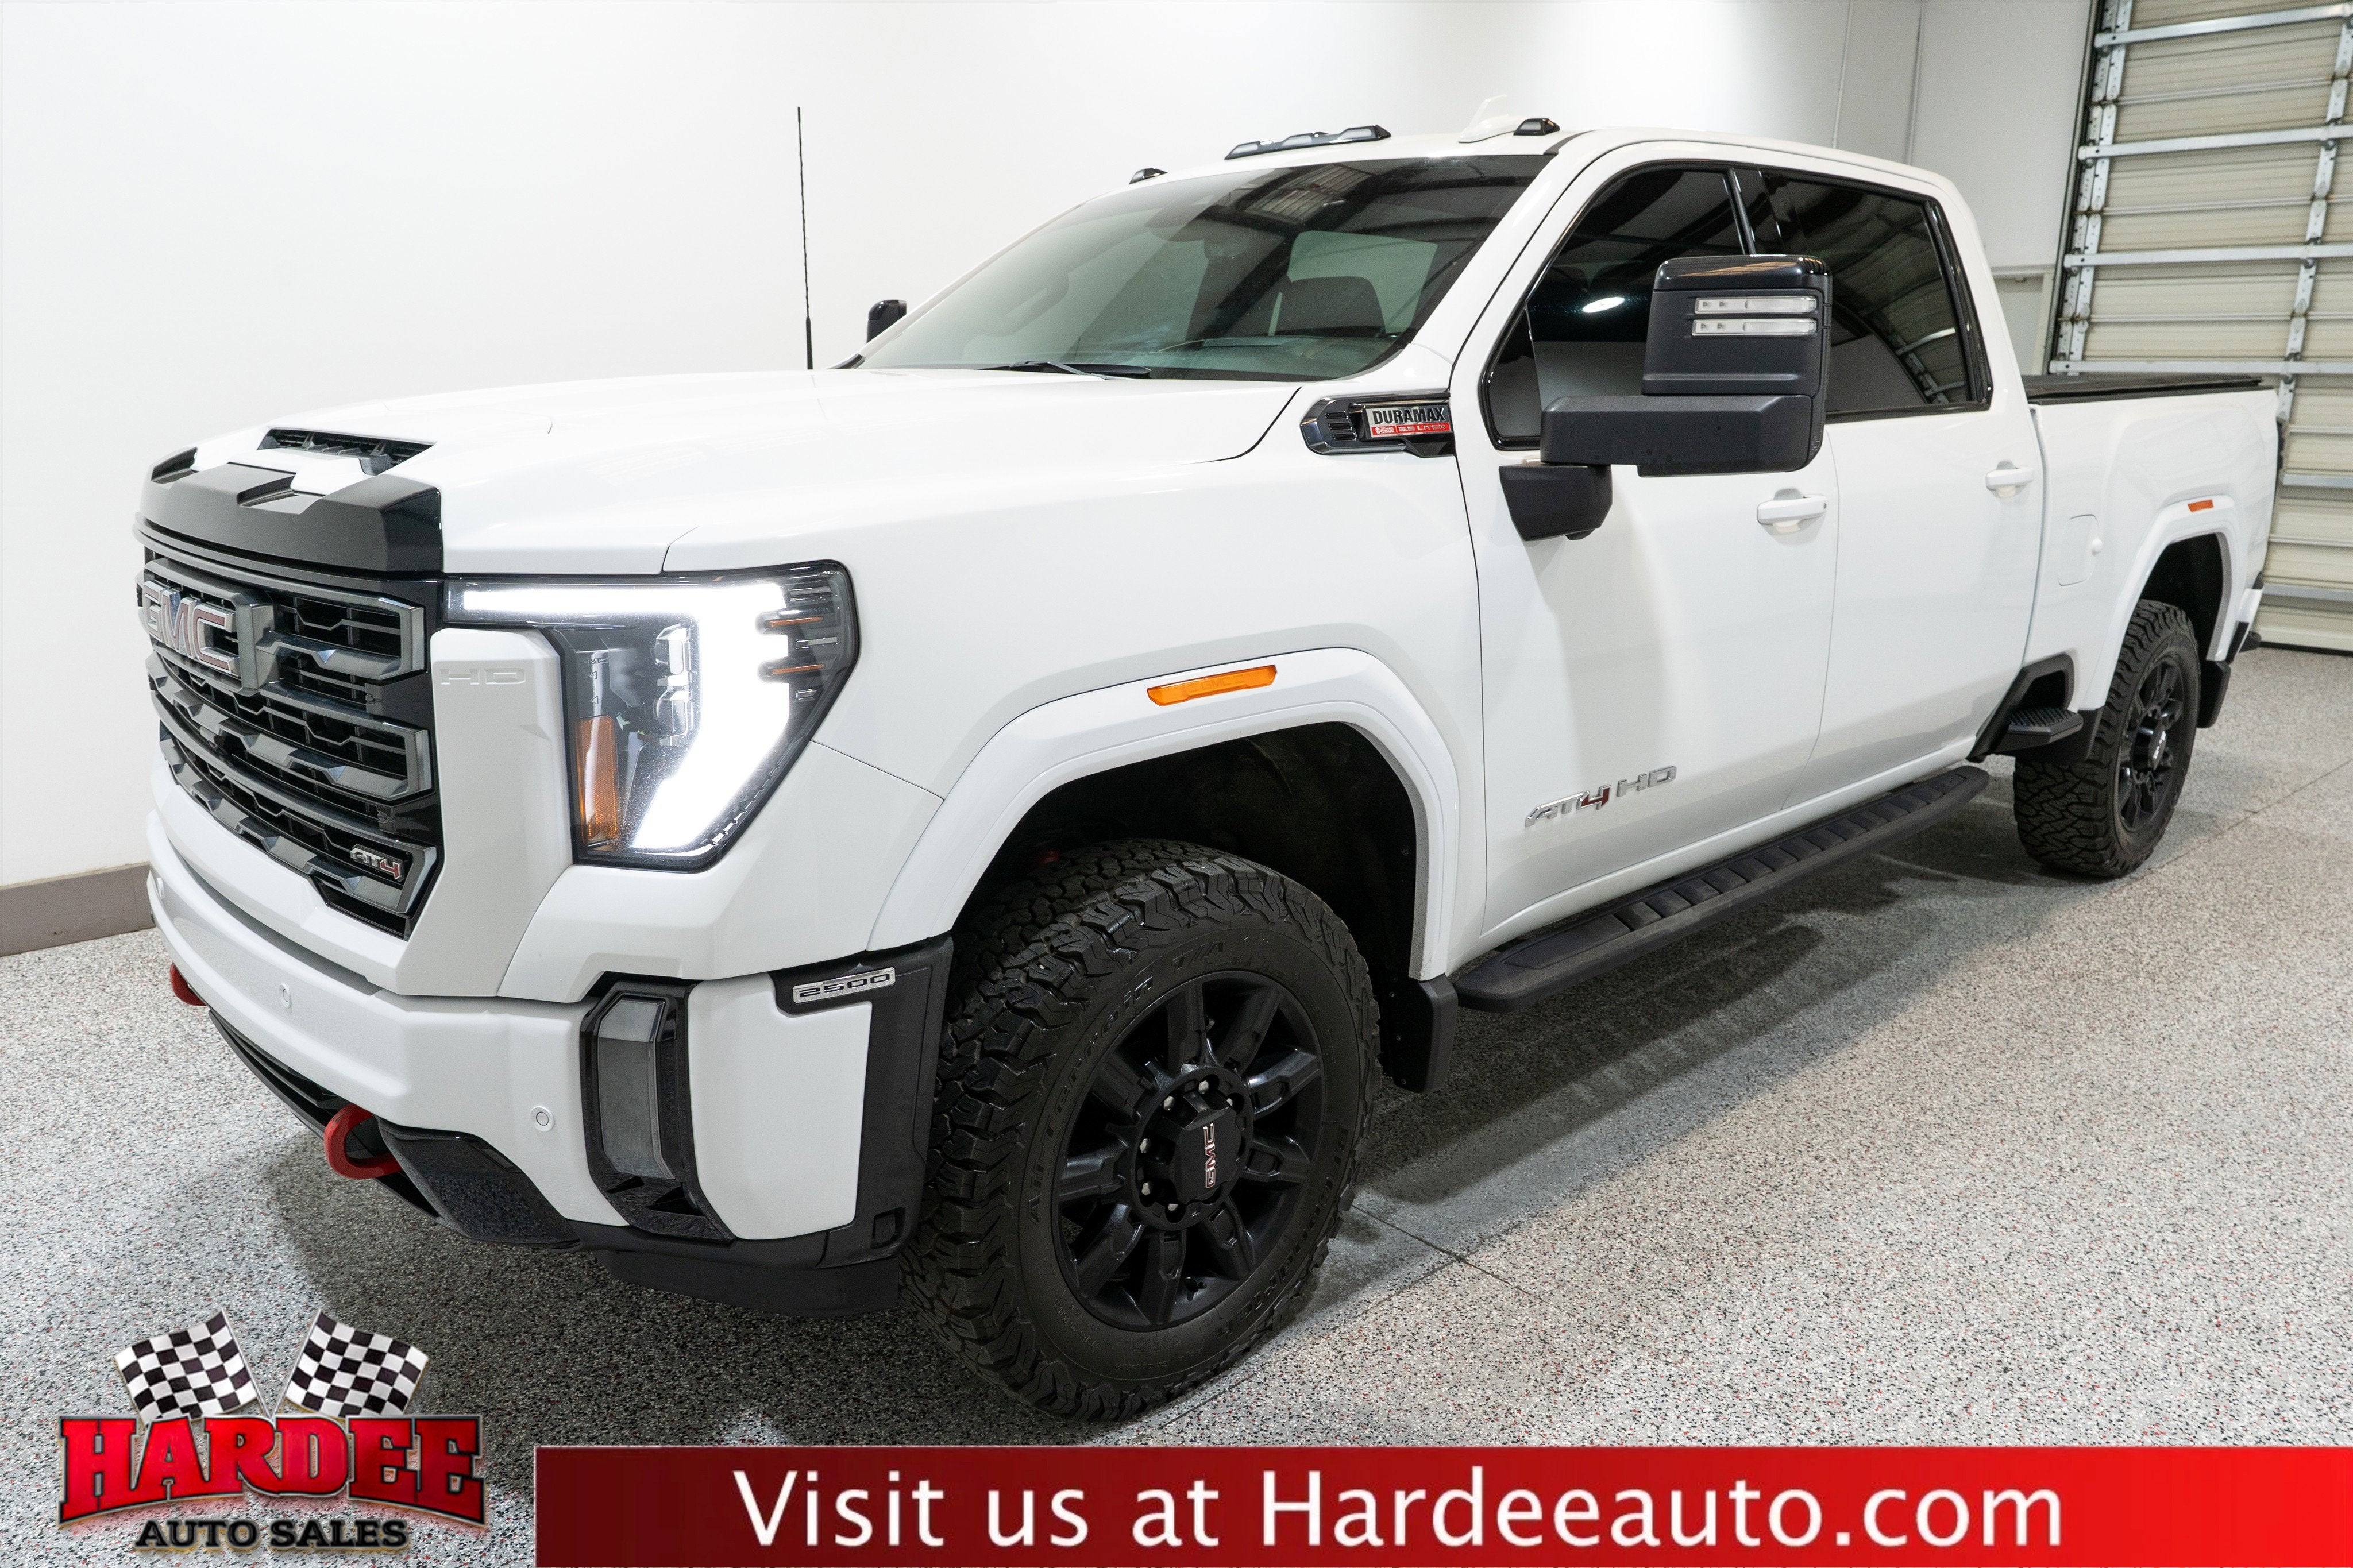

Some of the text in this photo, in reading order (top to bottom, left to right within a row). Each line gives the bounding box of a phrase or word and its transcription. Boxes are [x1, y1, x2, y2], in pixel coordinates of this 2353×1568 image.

[1372, 407, 1446, 424] DURAMAX
[143, 581, 240, 677] GMC
[440, 669, 526, 685] HD
[1525, 765, 1677, 827] AT4 HD
[350, 848, 401, 879] AT4
[799, 974, 890, 998] 2500
[1203, 1123, 1216, 1188] GMC
